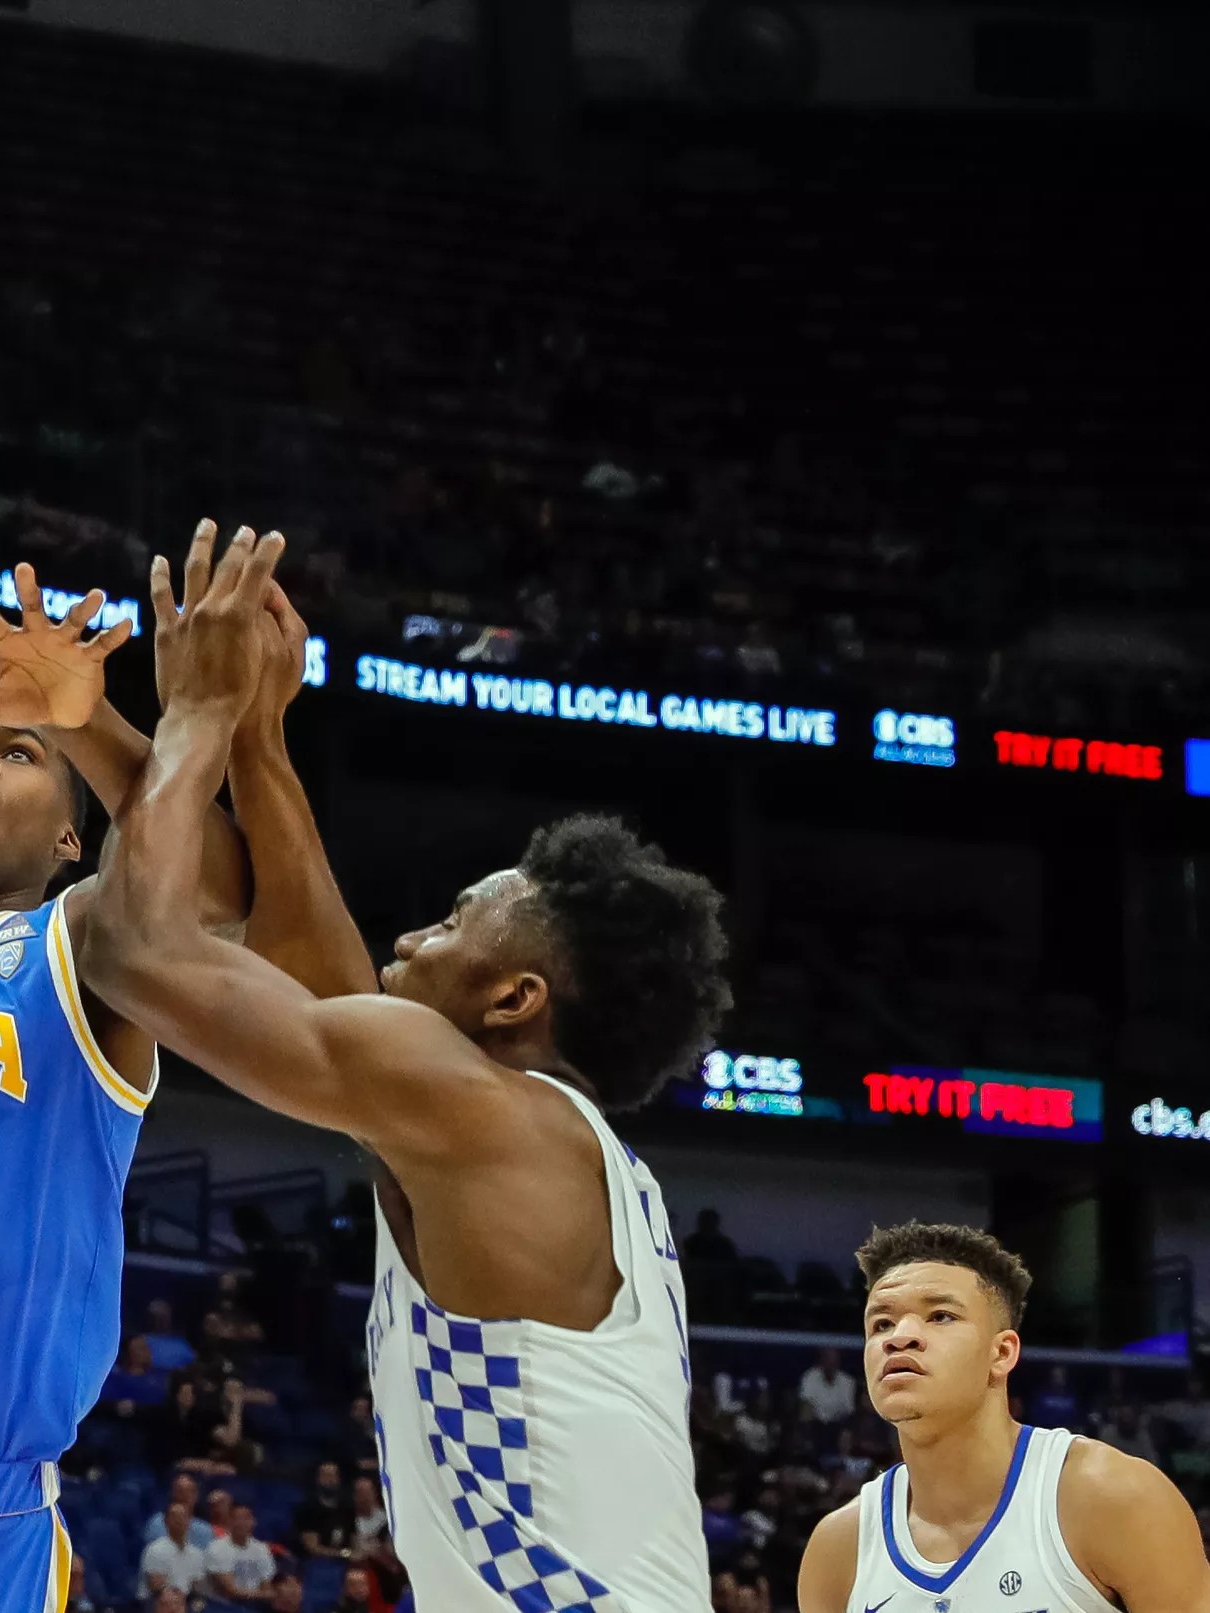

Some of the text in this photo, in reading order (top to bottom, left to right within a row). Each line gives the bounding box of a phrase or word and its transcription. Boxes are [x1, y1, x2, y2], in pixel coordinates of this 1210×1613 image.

[357, 655, 467, 708] STREAM
[471, 673, 553, 718] YOUR
[557, 683, 657, 728] LOCAL
[660, 695, 765, 741] GAMES
[767, 706, 836, 748] LIVE
[897, 713, 955, 748] CBS
[994, 730, 1051, 768] TRY
[1053, 737, 1083, 772] IT
[1086, 740, 1164, 781] FREE
[733, 1054, 802, 1093] CBS
[863, 1072, 1075, 1130] TRY IT FREE
